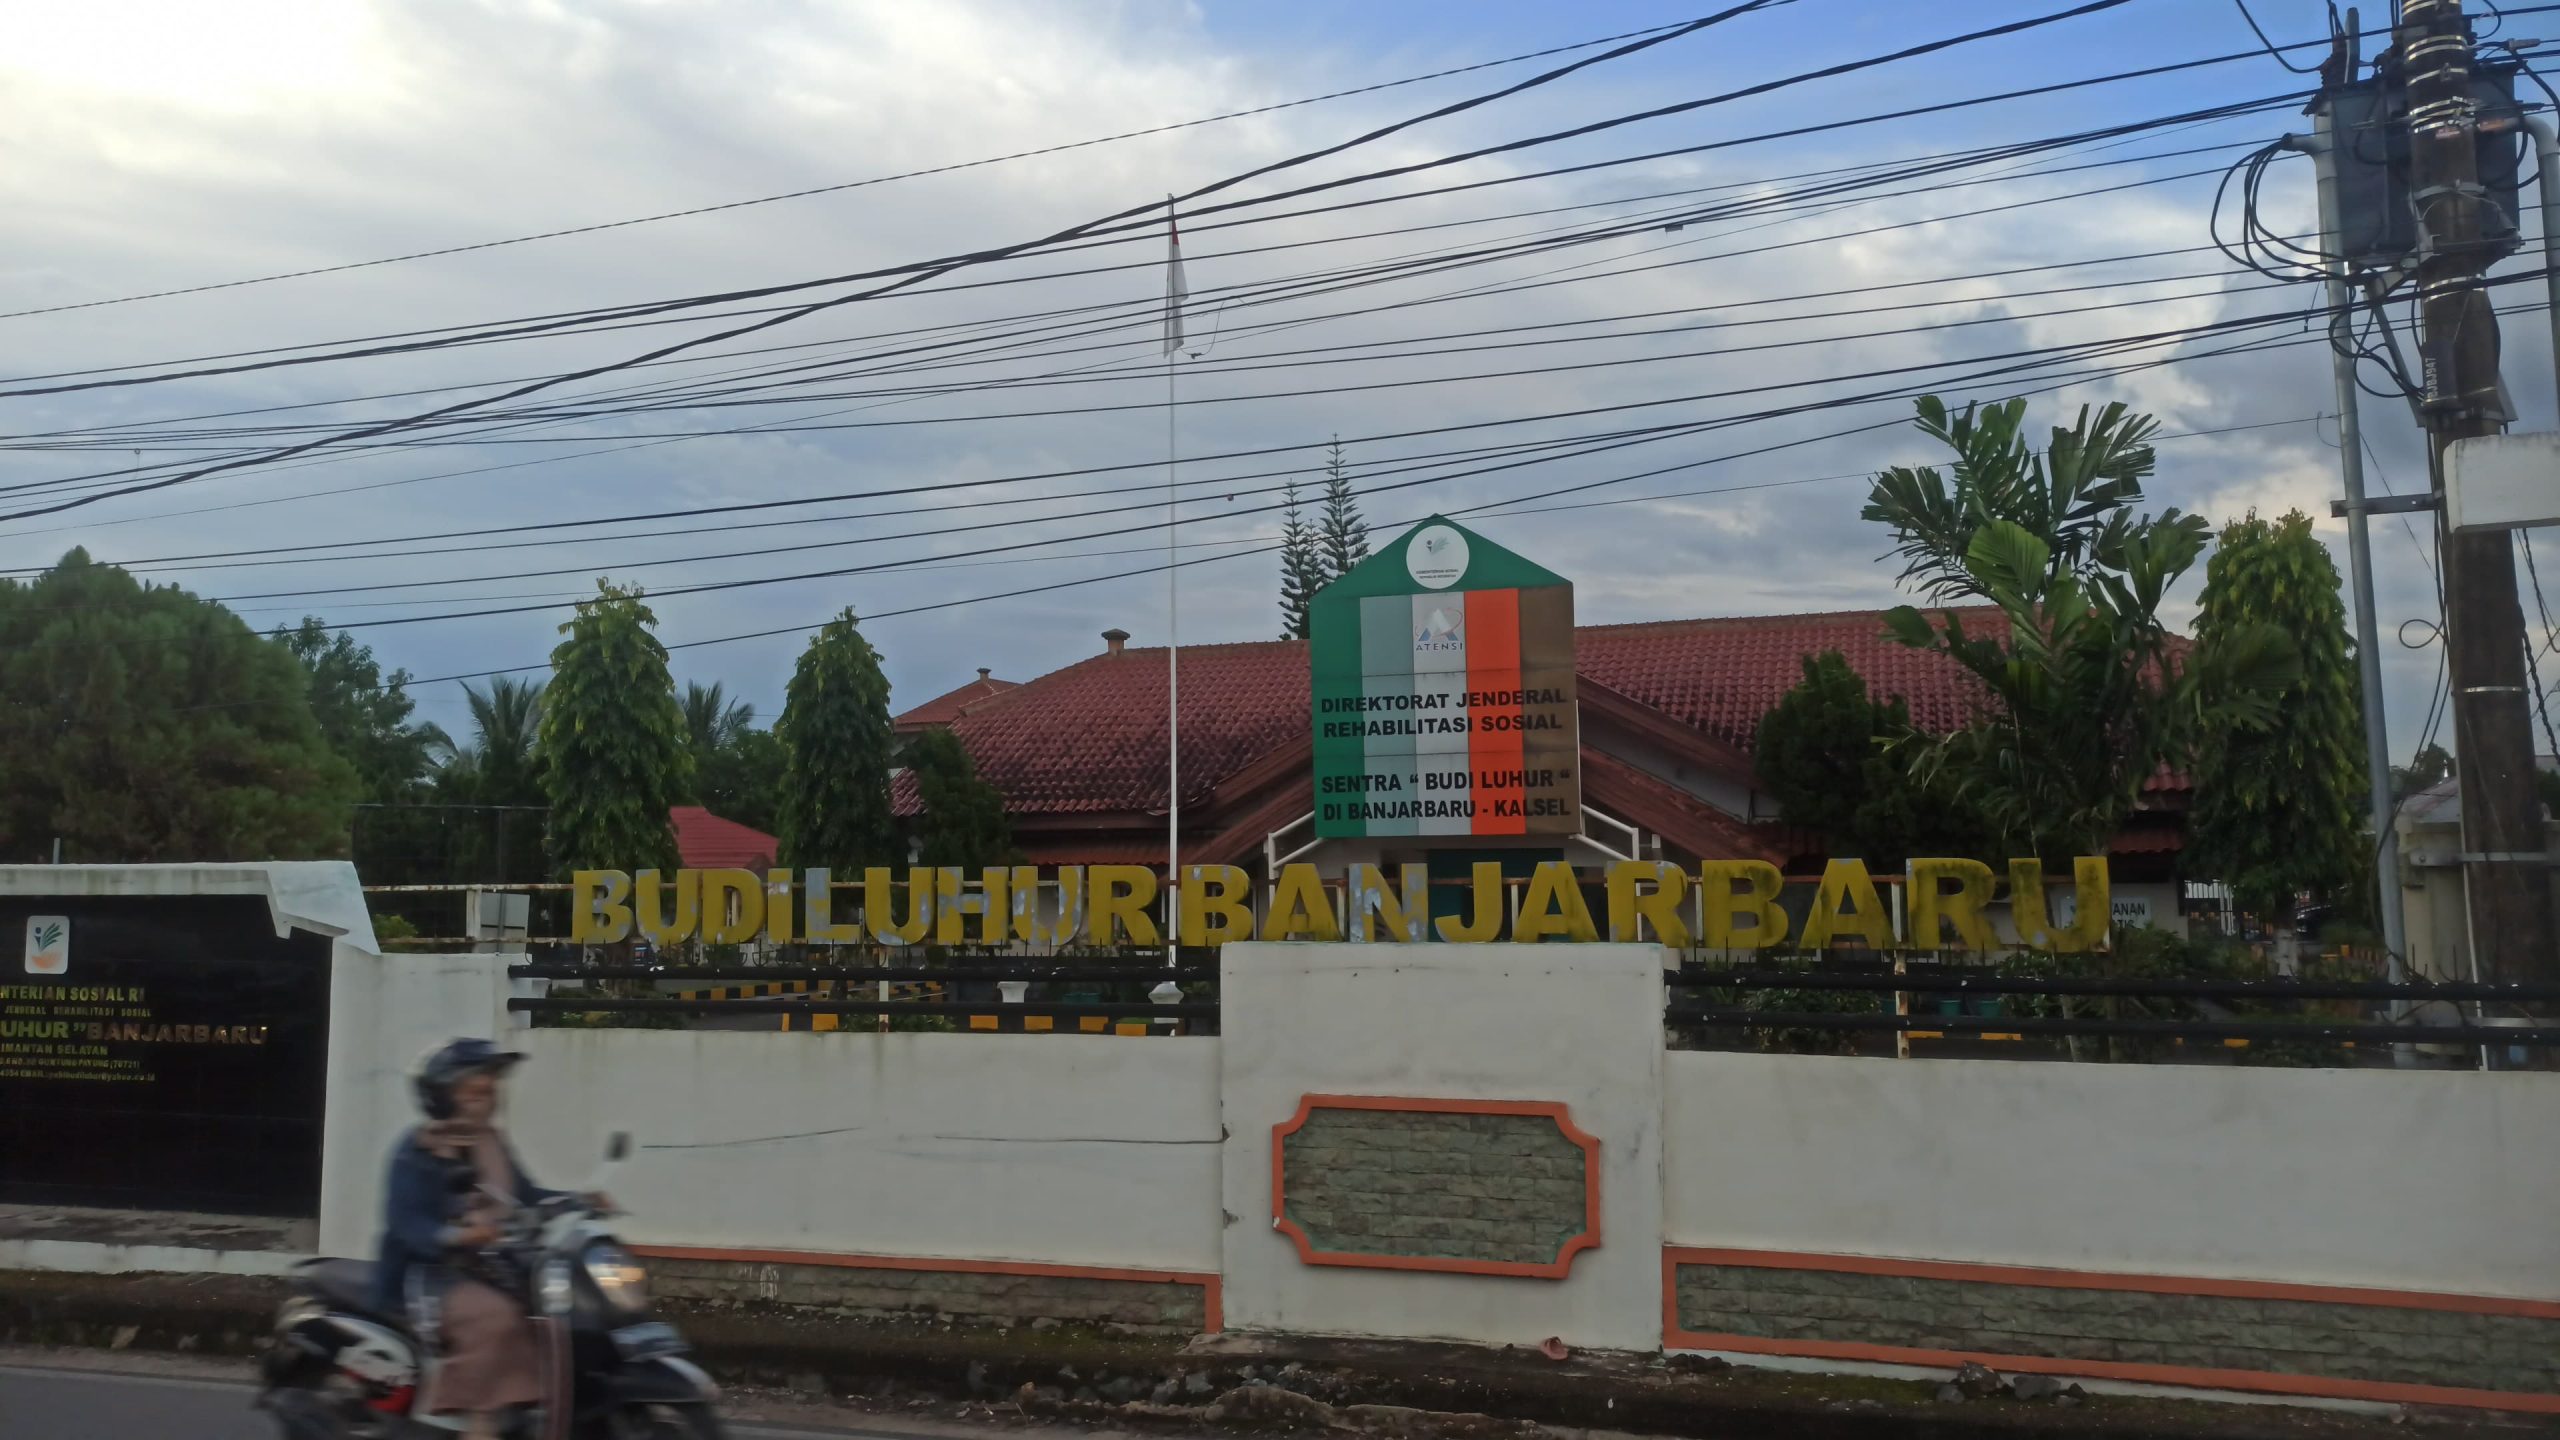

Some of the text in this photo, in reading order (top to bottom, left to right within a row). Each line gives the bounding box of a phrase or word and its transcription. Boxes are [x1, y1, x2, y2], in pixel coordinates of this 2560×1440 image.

[1416, 642, 1463, 651] ATENSI
[1321, 688, 1566, 713] DIREKTORAT JENDERAL
[1323, 714, 1563, 738] REHABILITASI SOSIAL
[1322, 774, 1402, 794] SENTRA
[1426, 771, 1473, 791] BUDI
[1481, 769, 1554, 789] LUHUR
[1323, 803, 1342, 821] DI
[1348, 800, 1476, 820] BANJARBARU
[1495, 798, 1571, 817] KALSEL
[1180, 856, 2111, 954] BANJARBARU
[0, 984, 145, 1002] NTERIAN SOSIAL RI
[121, 1007, 152, 1017] SOSIAL
[87, 1022, 268, 1044] BANJARBARU
[0, 1043, 108, 1055] IMANTAN SELATAN
